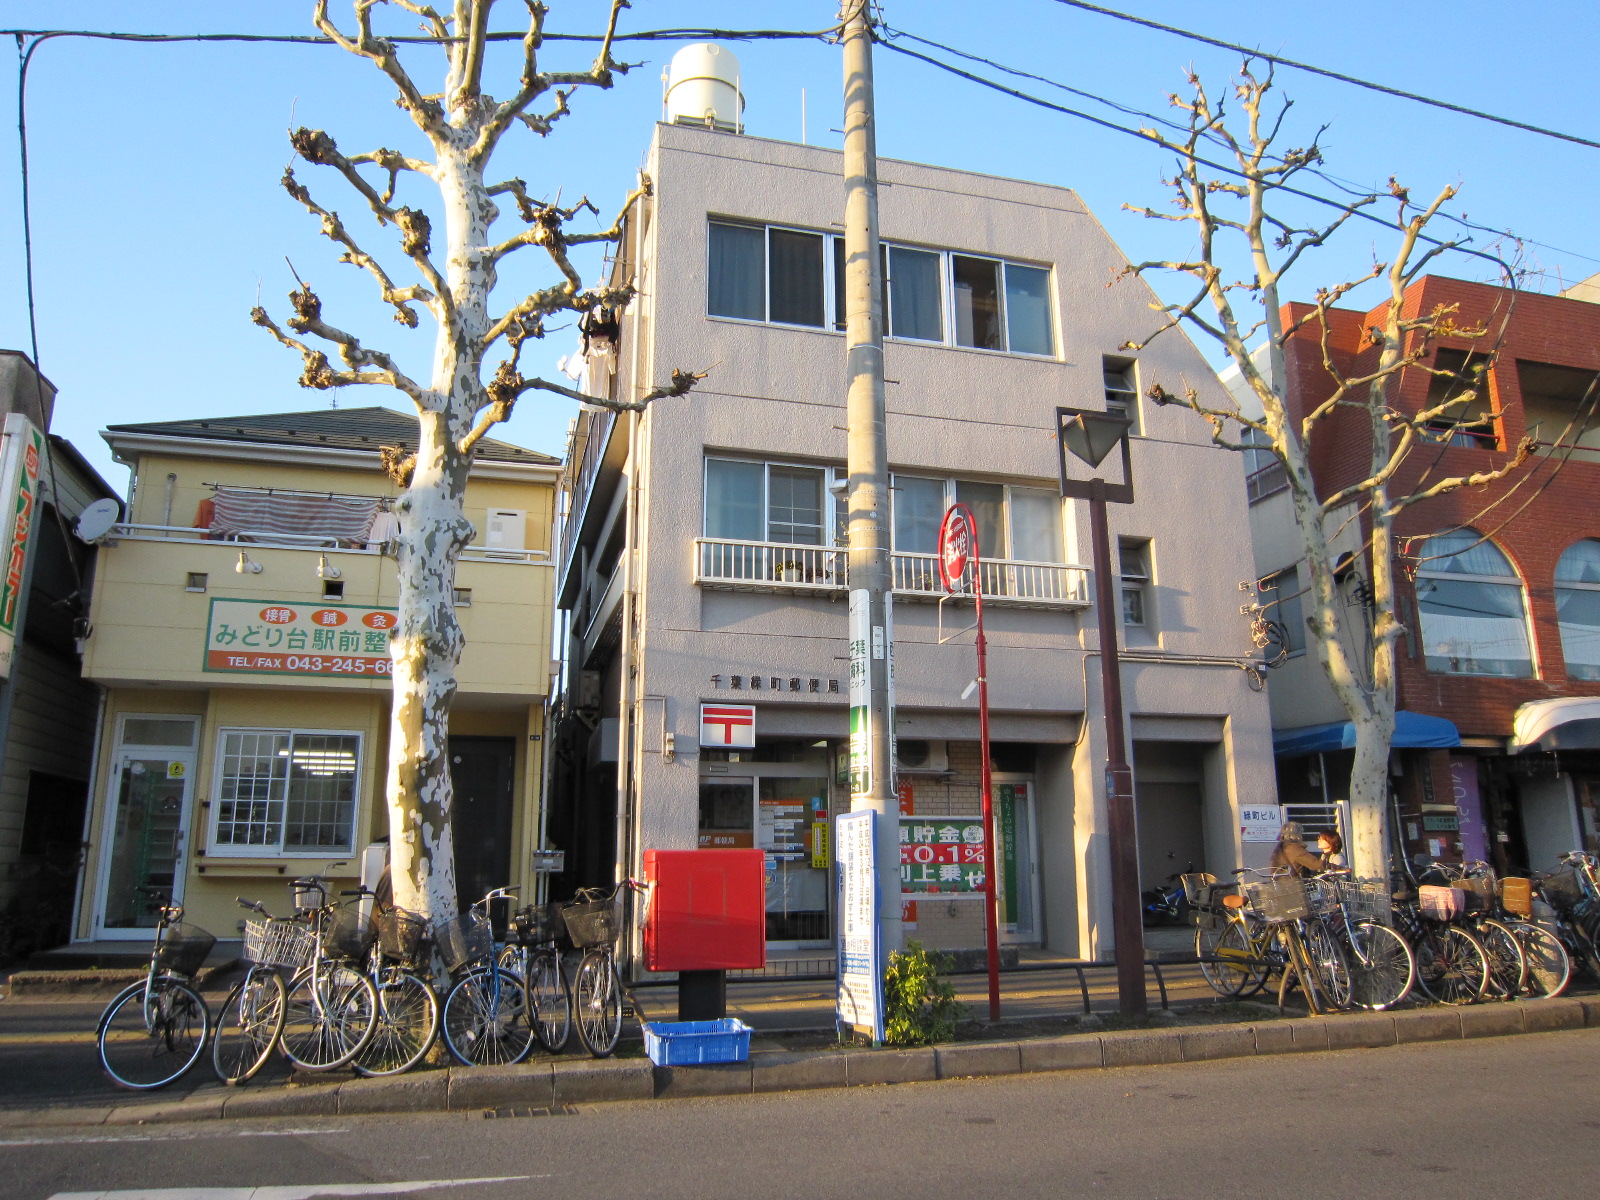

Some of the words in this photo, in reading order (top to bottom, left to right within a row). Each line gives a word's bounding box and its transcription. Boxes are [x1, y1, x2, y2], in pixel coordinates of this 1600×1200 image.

[4, 487, 32, 624] フジカラー
[265, 608, 291, 623] 接骨
[322, 611, 337, 625] 鍼
[372, 614, 387, 628] 灸
[227, 656, 281, 668] TEL/FAX
[710, 674, 839, 694] 千葉緑町郵便局
[1243, 810, 1276, 821] 緑町ビル
